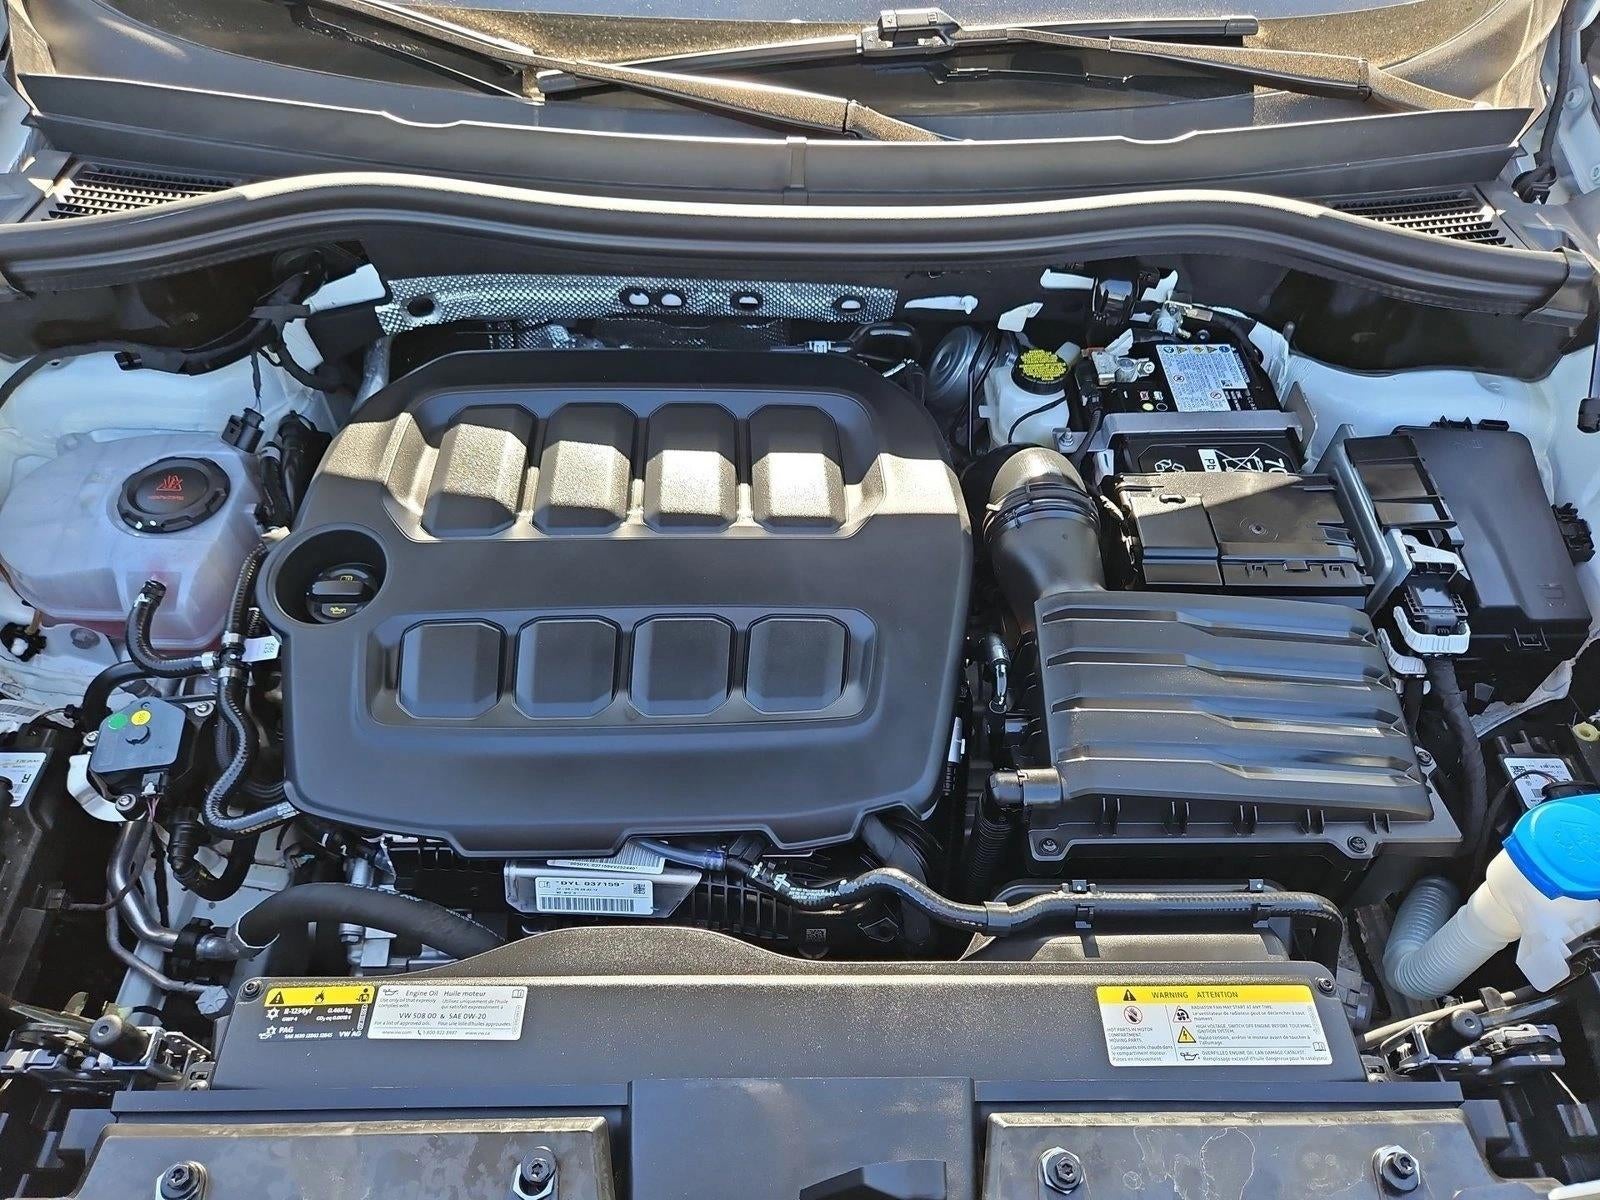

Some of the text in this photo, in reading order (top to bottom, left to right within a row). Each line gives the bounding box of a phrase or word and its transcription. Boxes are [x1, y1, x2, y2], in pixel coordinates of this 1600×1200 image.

[1204, 458, 1216, 470] Pb
[22, 773, 32, 783] R
[405, 990, 427, 998] Engine
[1151, 991, 1238, 999] WARNING ATTENTION
[283, 1007, 314, 1016] R-1234yf
[278, 1026, 294, 1034] PAG
